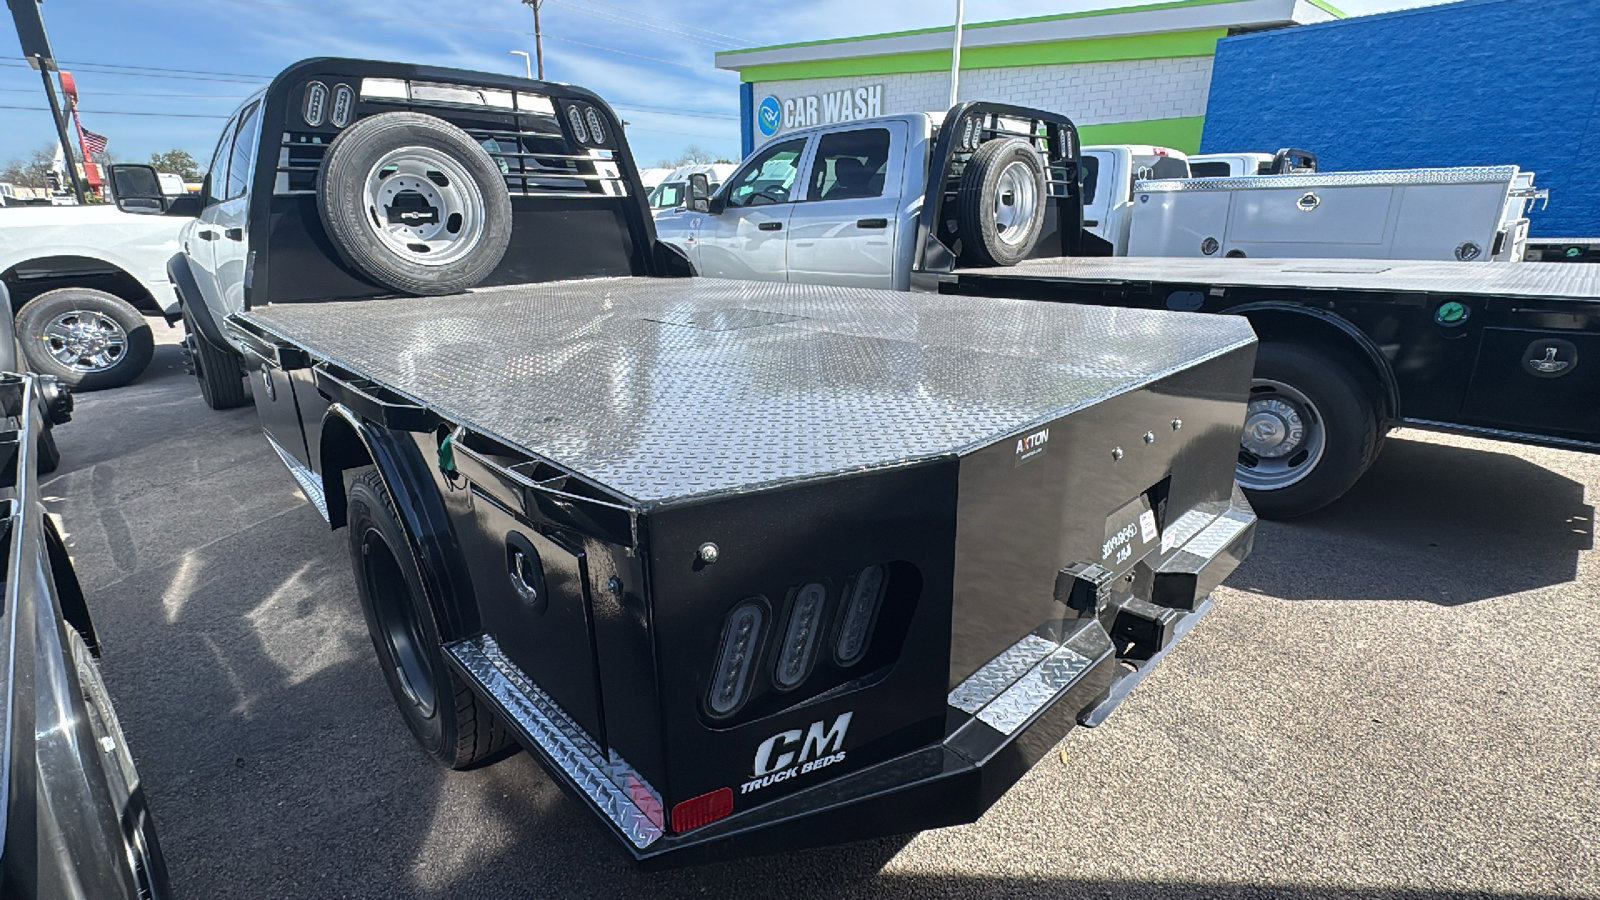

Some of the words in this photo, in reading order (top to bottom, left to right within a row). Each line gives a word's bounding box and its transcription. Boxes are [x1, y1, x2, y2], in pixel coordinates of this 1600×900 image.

[783, 96, 818, 128] CAR
[822, 85, 882, 124] WASH
[1016, 428, 1049, 454] AXTON
[754, 712, 853, 776] CM
[741, 766, 799, 794] TRUCK
[801, 751, 847, 774] BEDS
